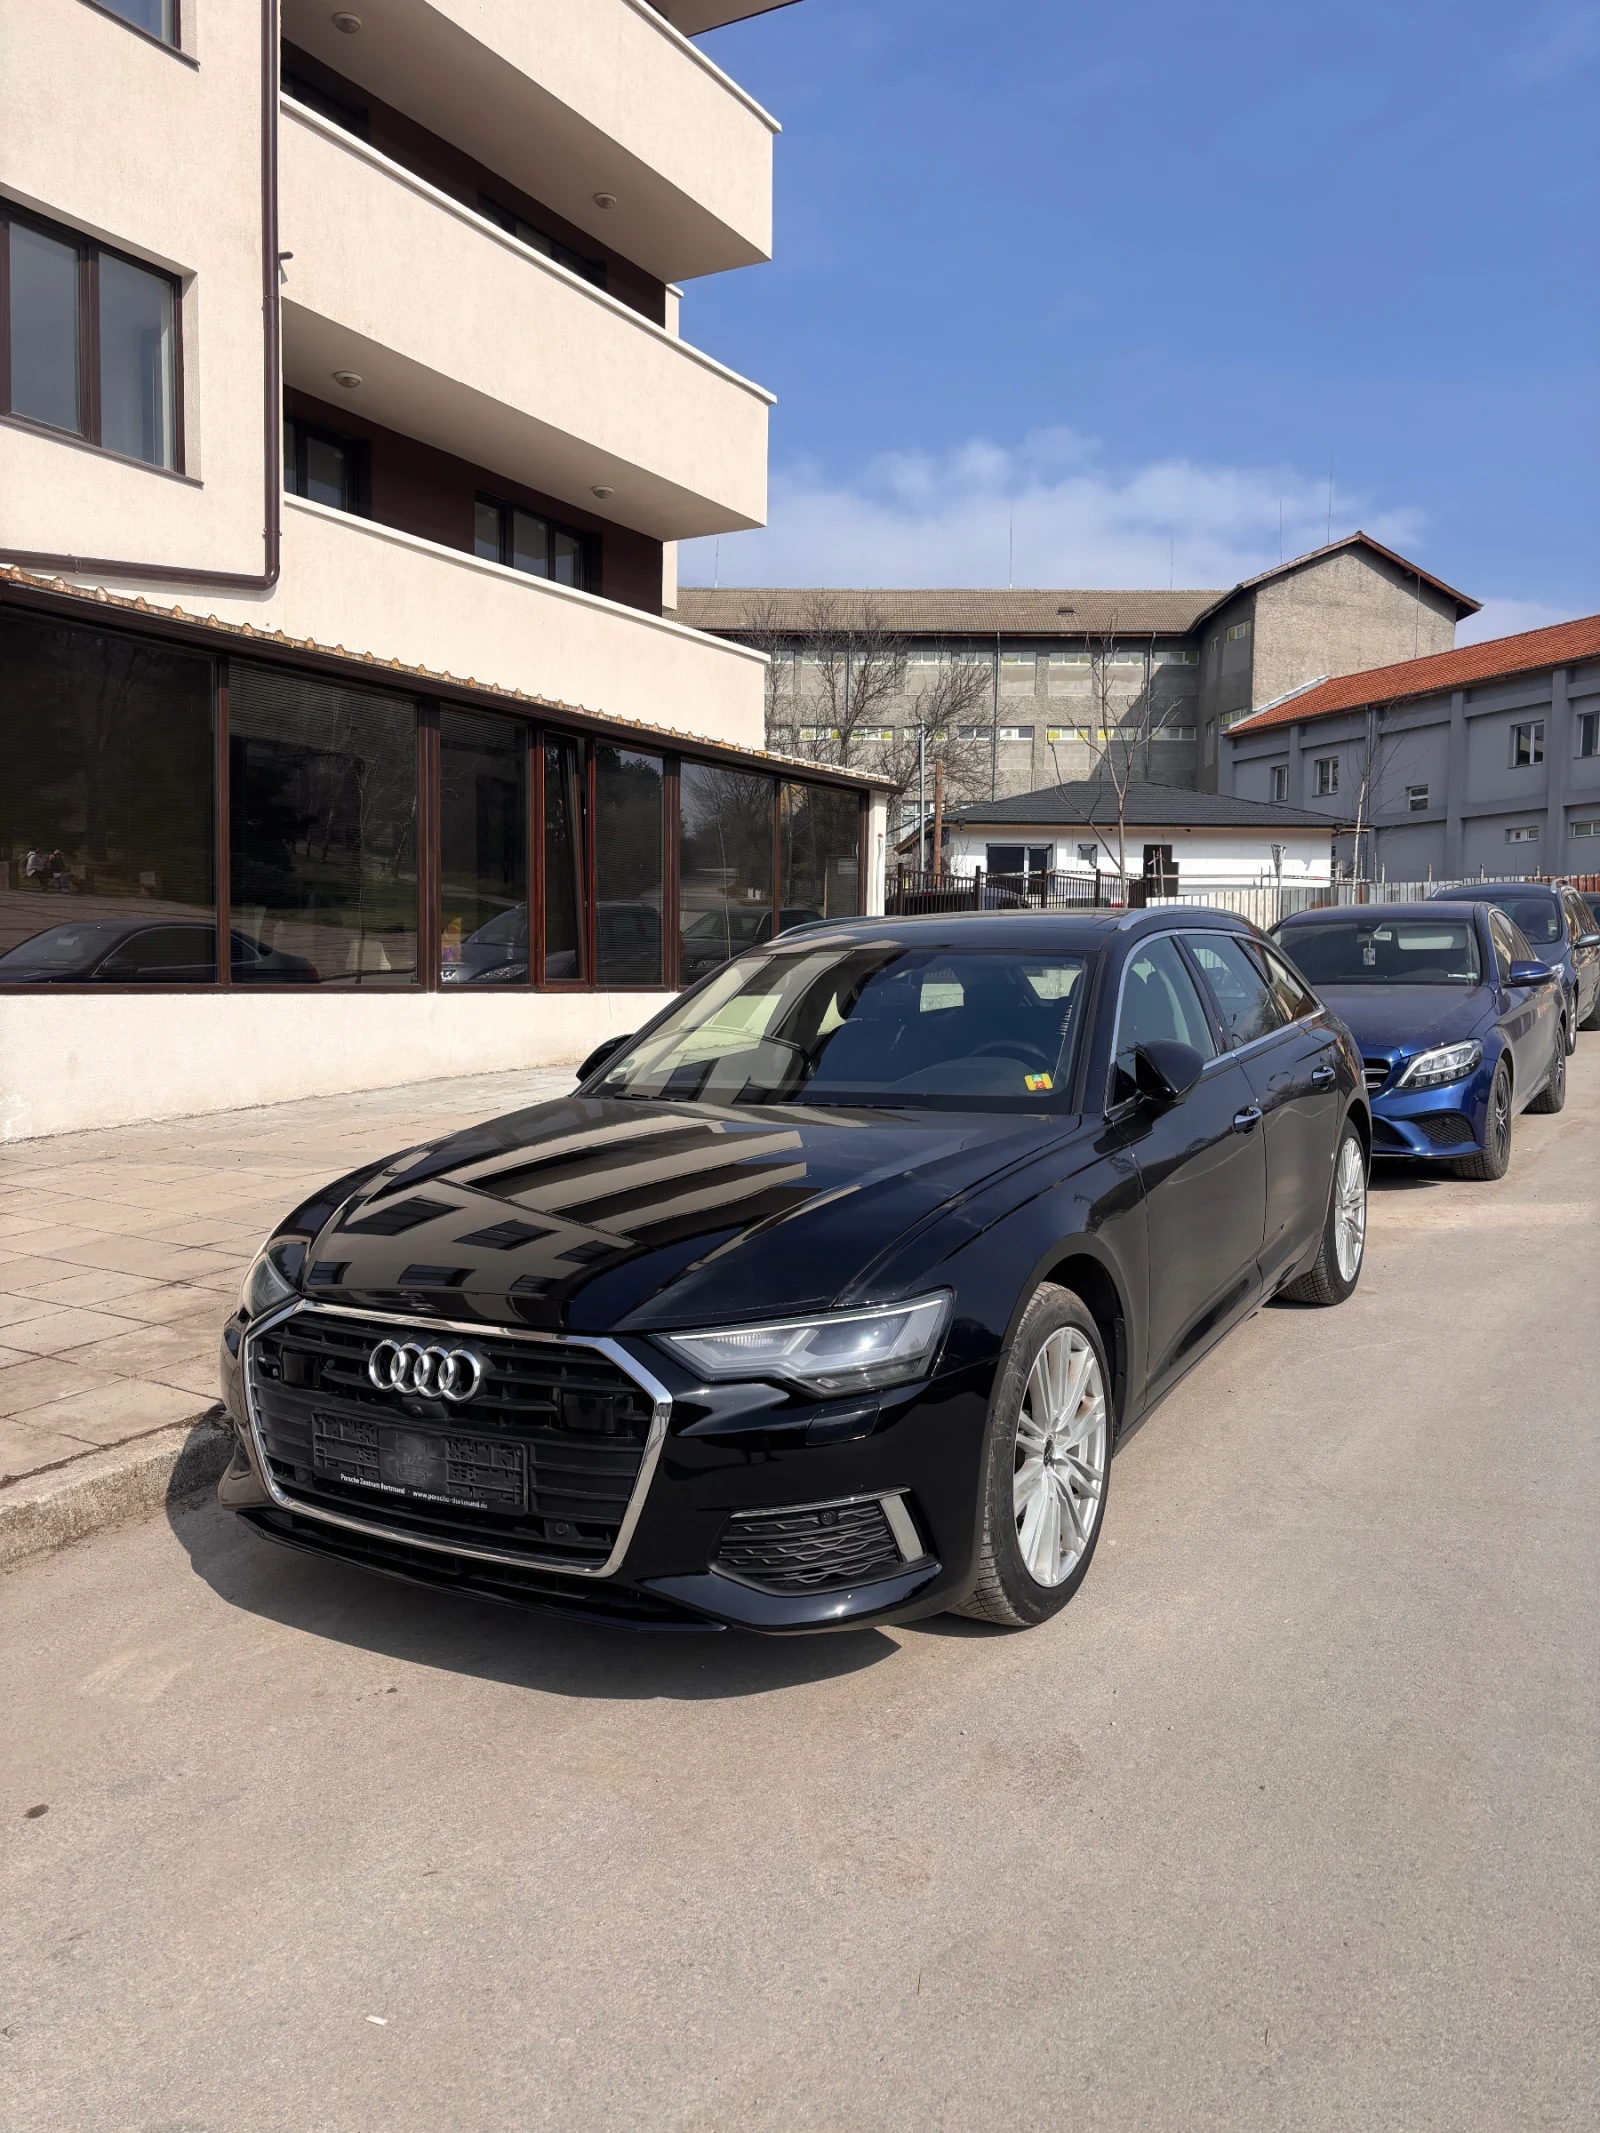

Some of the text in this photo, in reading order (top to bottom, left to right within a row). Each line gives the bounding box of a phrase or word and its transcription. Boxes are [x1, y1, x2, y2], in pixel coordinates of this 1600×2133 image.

[340, 1473, 360, 1485] Porsche
[359, 1478, 381, 1490] Zentrum
[380, 1482, 406, 1495] Dortmund
